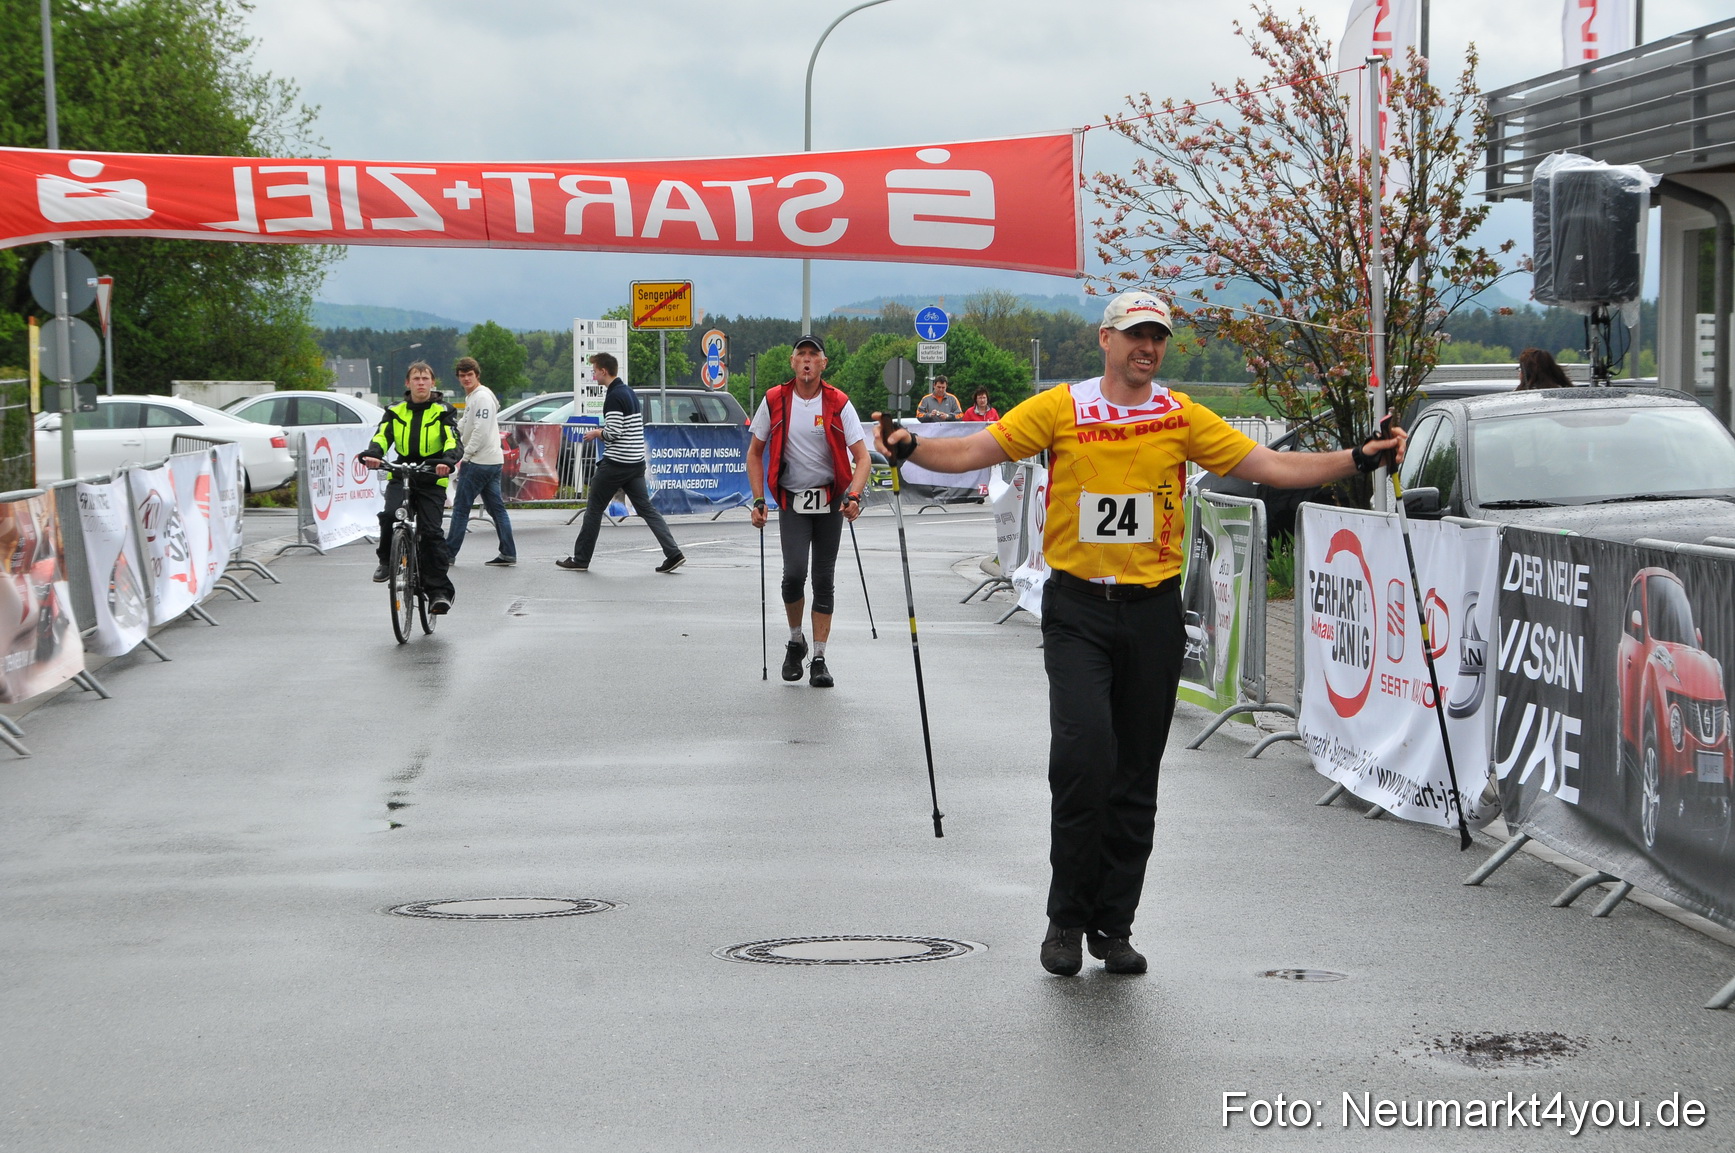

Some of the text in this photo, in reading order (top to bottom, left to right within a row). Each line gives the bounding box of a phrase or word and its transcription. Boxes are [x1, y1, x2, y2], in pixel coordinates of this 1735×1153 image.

[637, 288, 687, 303] Sengenthal
[658, 303, 680, 311] Anger
[586, 386, 603, 398] THULE
[475, 408, 489, 419] 48
[1076, 426, 1129, 445] MAX
[651, 447, 741, 459] SAISONSTART BEI NISSAN:
[650, 464, 672, 474] GANZ
[673, 463, 689, 474] WEIT
[690, 463, 711, 474] VORN
[711, 463, 724, 473] MIT
[649, 479, 719, 490] WINTERANGEBOTEN
[803, 489, 820, 510] 21
[1096, 497, 1139, 537] 24
[1502, 552, 1590, 608] DER NEUE
[1309, 569, 1363, 622] GERHART
[1332, 620, 1370, 670] JÄNIG
[1380, 673, 1409, 699] SEAT
